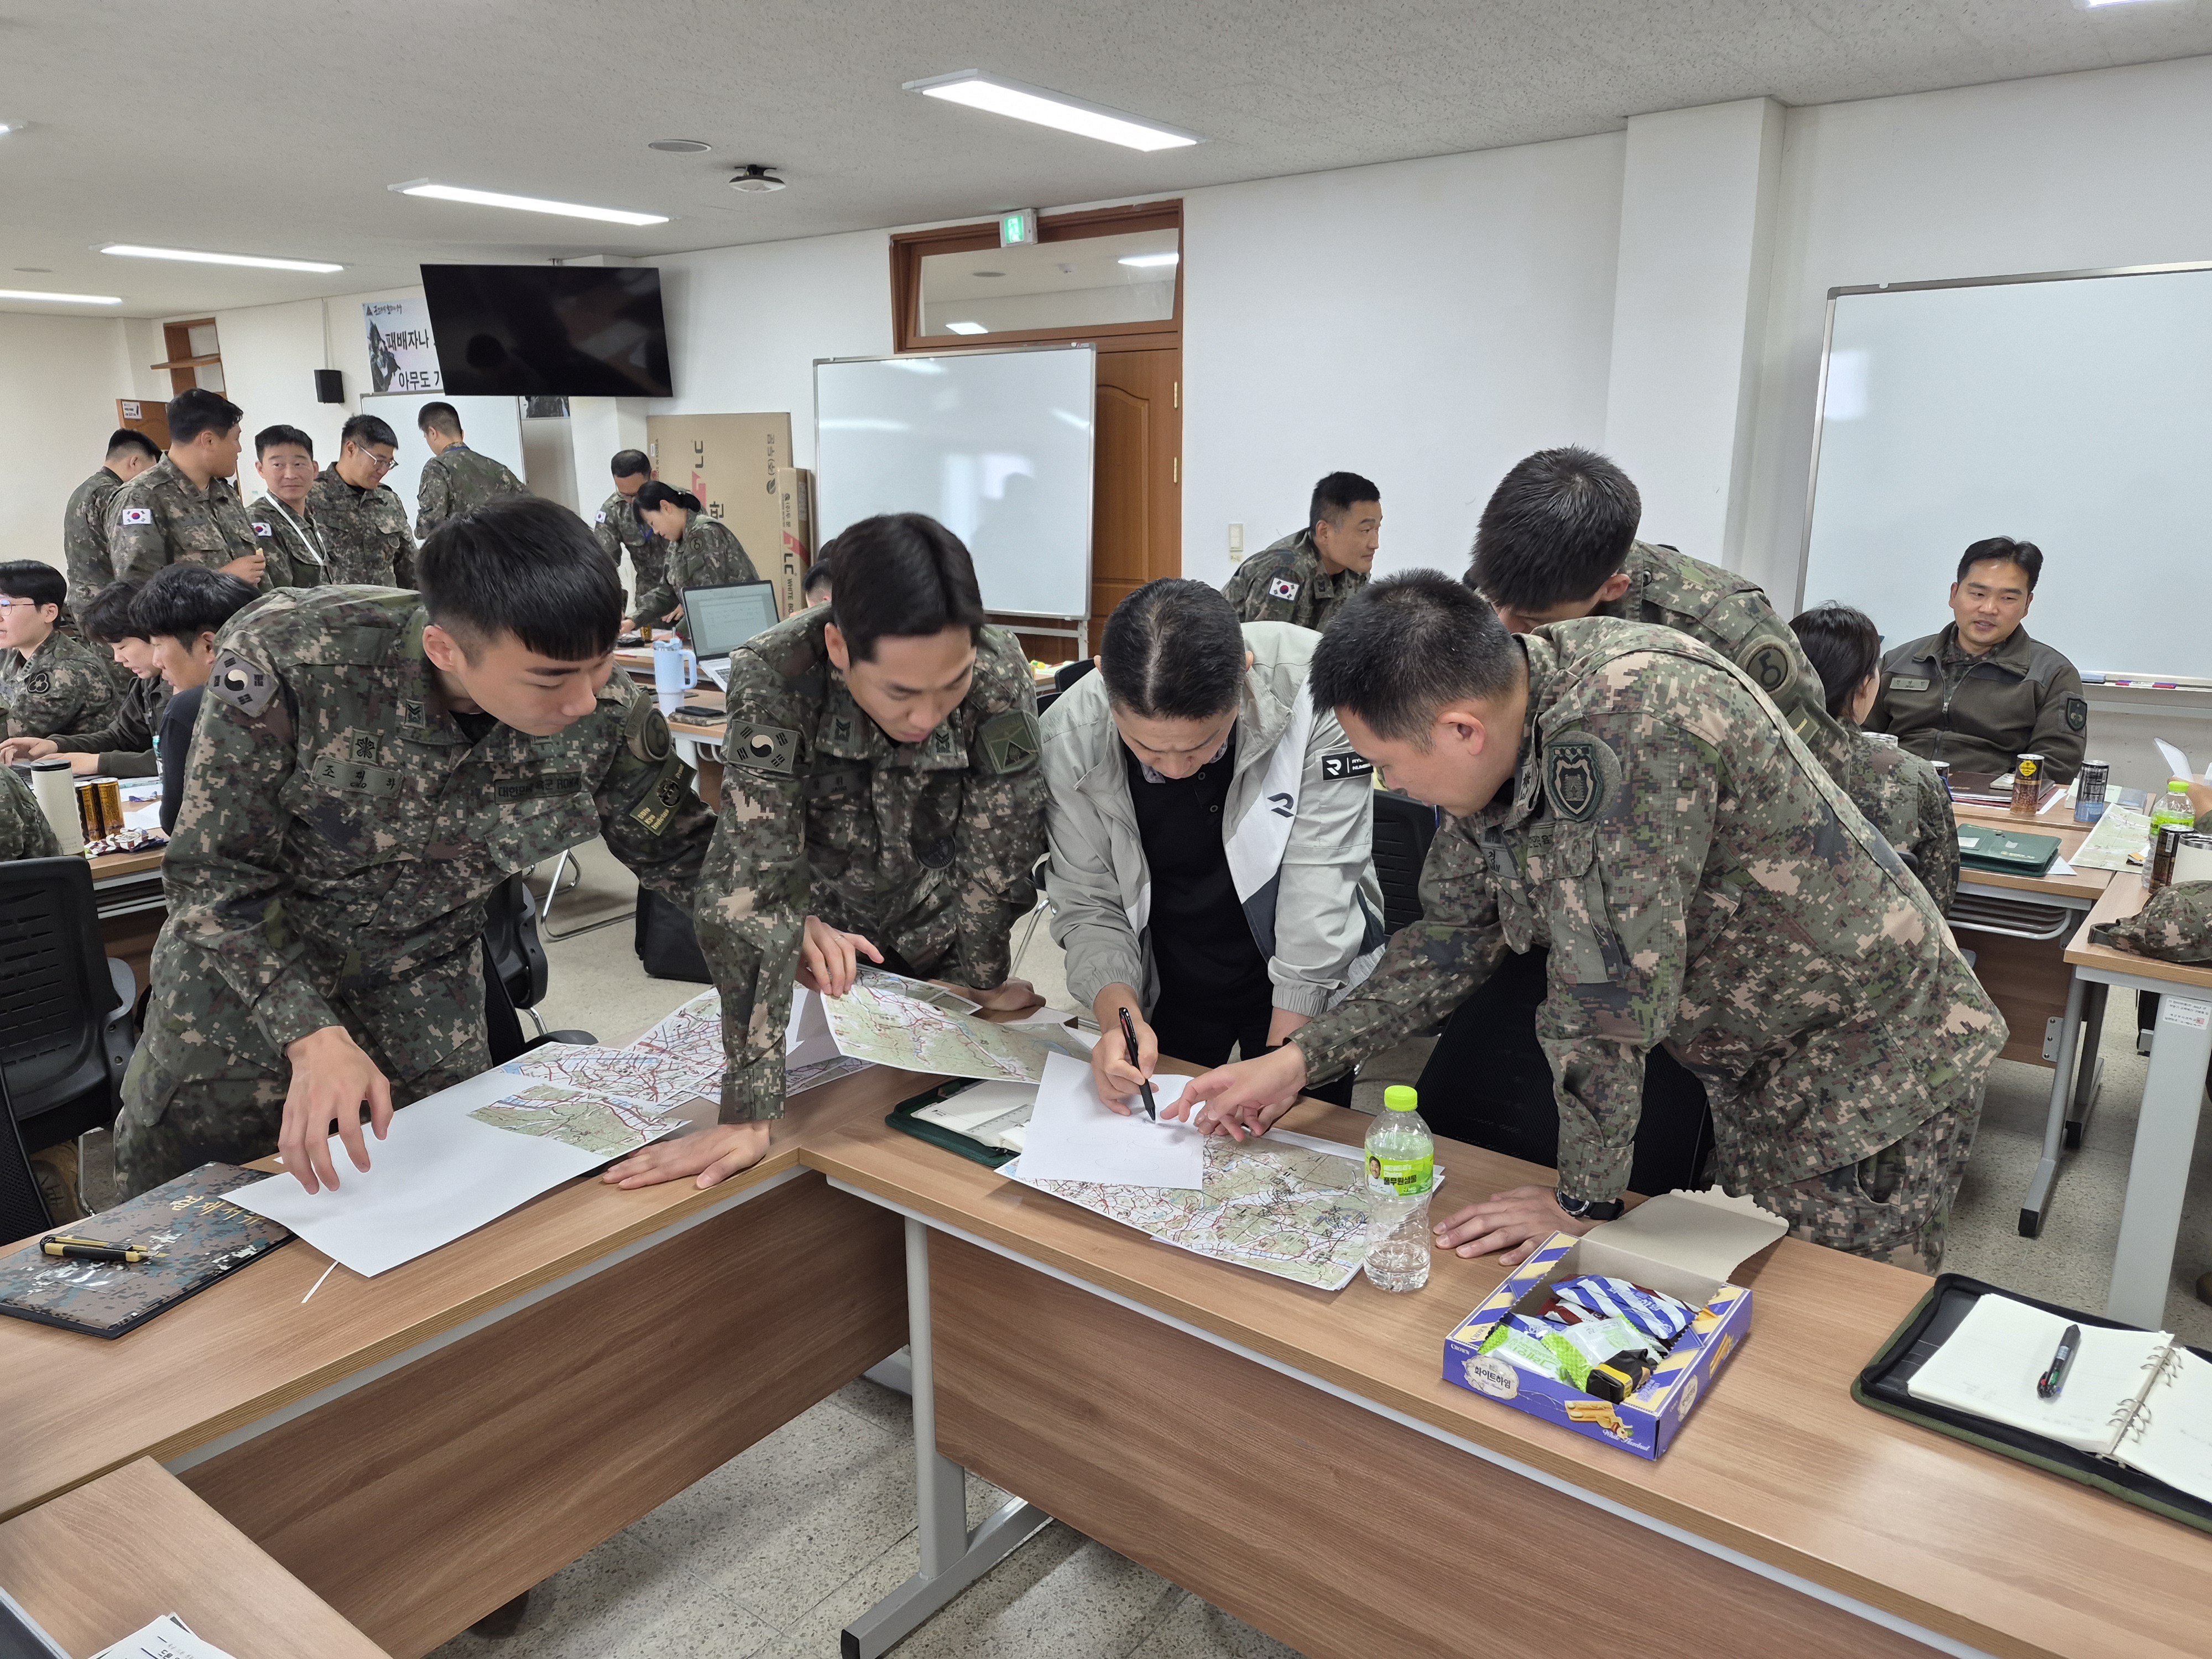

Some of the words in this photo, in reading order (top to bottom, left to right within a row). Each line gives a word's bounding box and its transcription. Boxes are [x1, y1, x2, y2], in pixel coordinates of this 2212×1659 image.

[385, 329, 429, 351] 패배자나
[399, 371, 431, 390] 아무도
[557, 777, 579, 790] ROKA
[1384, 1174, 1417, 1186] 풀무원샘물
[1470, 1326, 1488, 1340] CROWN
[1451, 1343, 1470, 1355] CROWN
[1475, 1366, 1511, 1390] 화이트하임
[1603, 1429, 1620, 1441] White
[1620, 1438, 1651, 1451] Hazelnut
